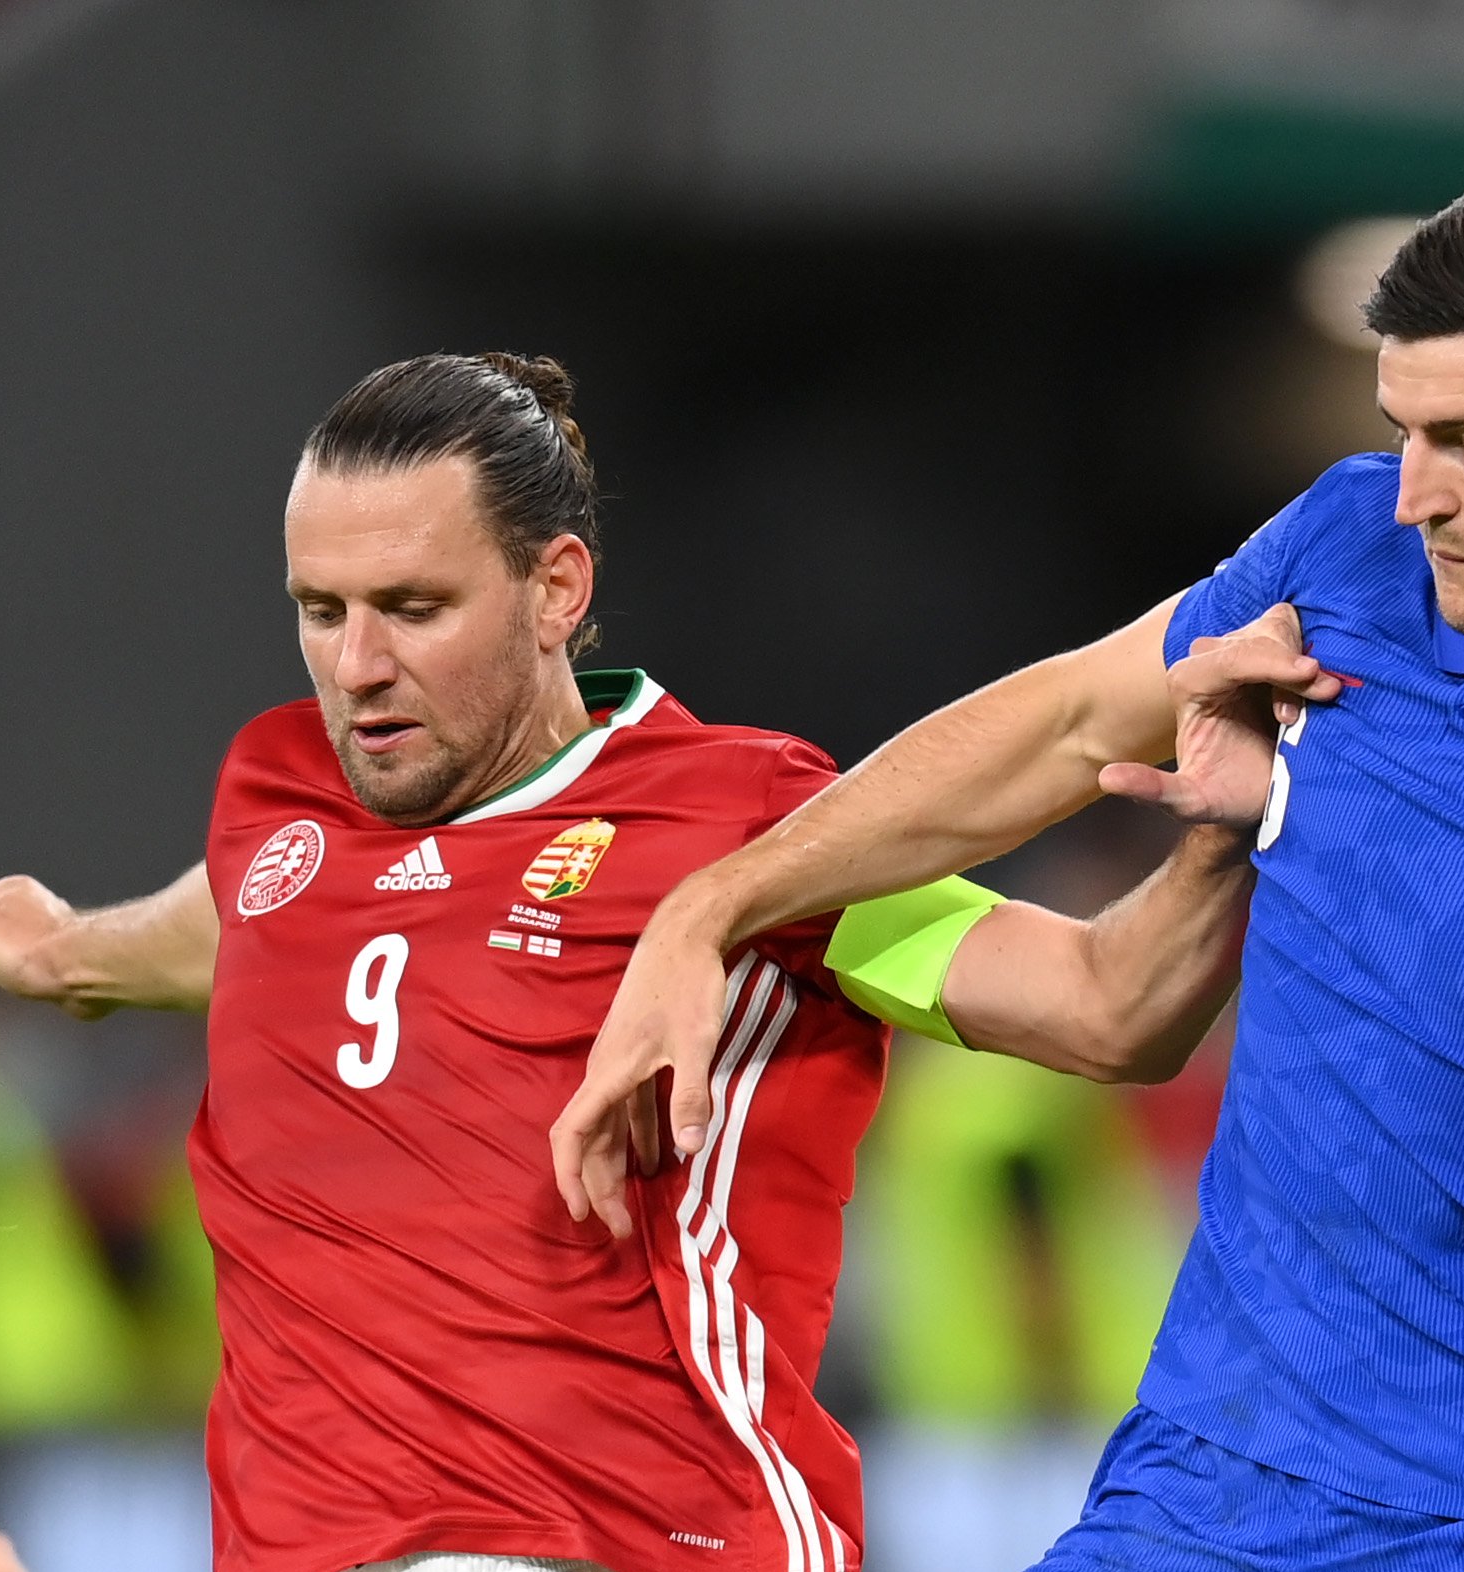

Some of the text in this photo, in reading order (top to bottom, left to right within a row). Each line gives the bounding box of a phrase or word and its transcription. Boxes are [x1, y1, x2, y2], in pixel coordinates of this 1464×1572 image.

[374, 871, 452, 891] adidas
[507, 914, 558, 931] BUDAPEST
[511, 903, 561, 924] 02.09.2021
[336, 932, 410, 1090] 9
[669, 1531, 725, 1550] AEROREADY
